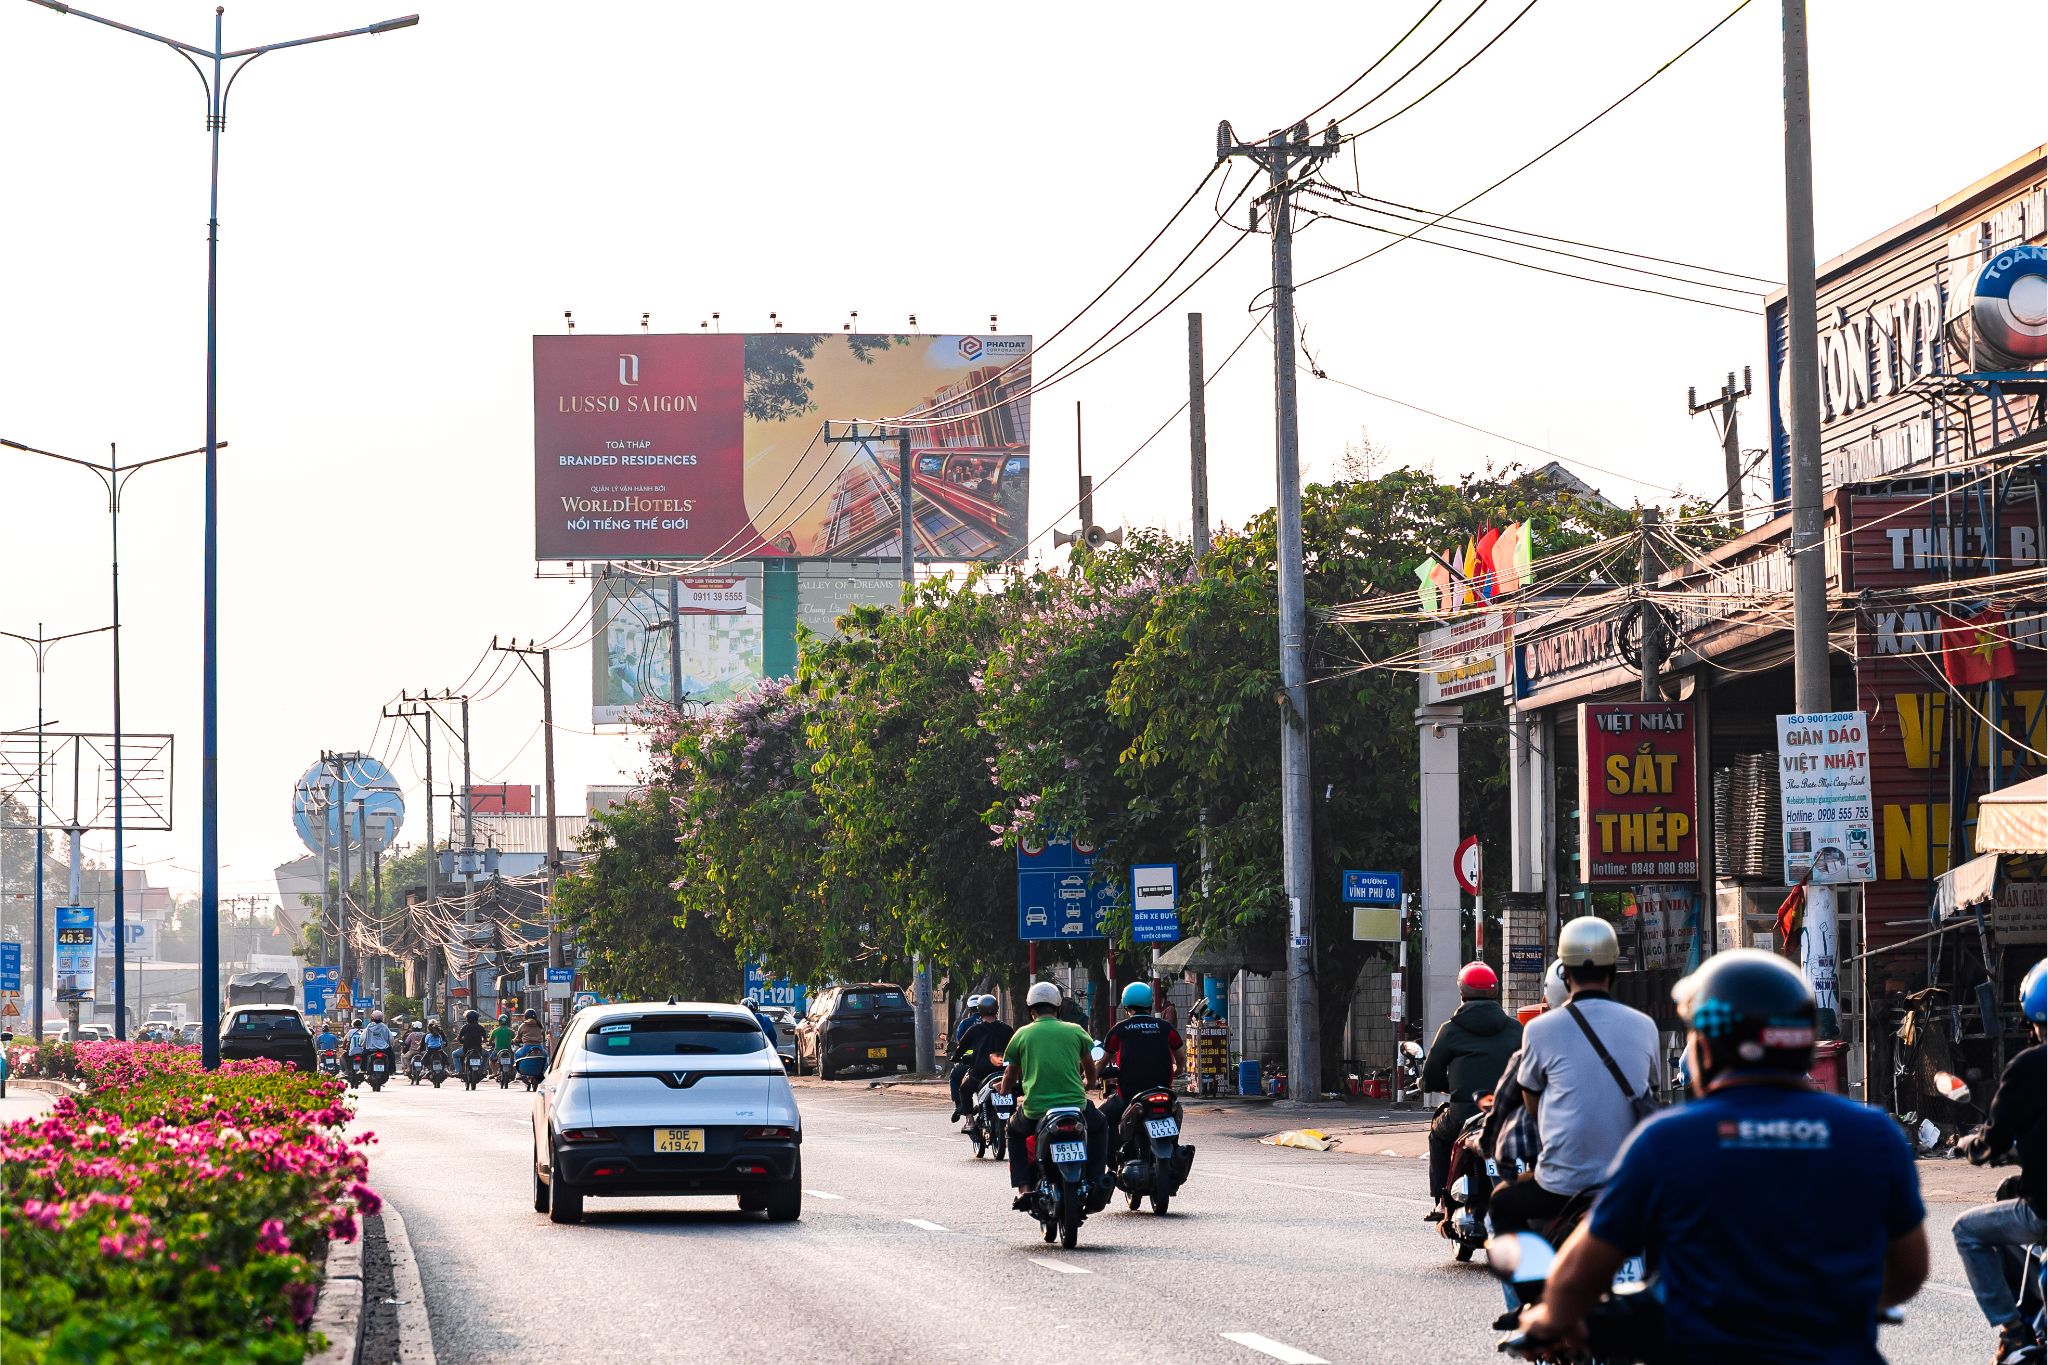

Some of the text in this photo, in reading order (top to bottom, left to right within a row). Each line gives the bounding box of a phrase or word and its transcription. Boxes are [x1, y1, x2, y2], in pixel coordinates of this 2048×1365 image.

[559, 395, 698, 413] LUSSO SAIGON
[627, 440, 651, 449] THÁP
[559, 455, 697, 466] BRANDED RESIDENCES
[567, 516, 689, 530] NỔI TIẾNG THẾ GIỚI
[853, 580, 894, 589] DREAMS
[693, 592, 743, 600] 0911 39 5555
[1596, 707, 1684, 734] VIỆT NHẬT
[1788, 713, 1854, 724] ISO 9001:2008
[1786, 725, 1861, 746] GIÀN DÁO
[1783, 750, 1866, 774] VIỆT NHẬT
[1606, 742, 1678, 795] SẮT
[1786, 806, 1868, 822] Hotline: 0908 555 755
[1596, 806, 1689, 853] THÉP
[1592, 862, 1696, 876] Hotline: 0848 080 888
[1349, 884, 1396, 898] VĨNH PHÚ 08
[1134, 912, 1148, 920] BẾN
[60, 934, 84, 944] 48.3
[668, 1130, 690, 1141] 50E
[660, 1141, 698, 1152] 419.47
[1056, 1144, 1080, 1152] 66-L1
[1055, 1152, 1084, 1162] 733.76
